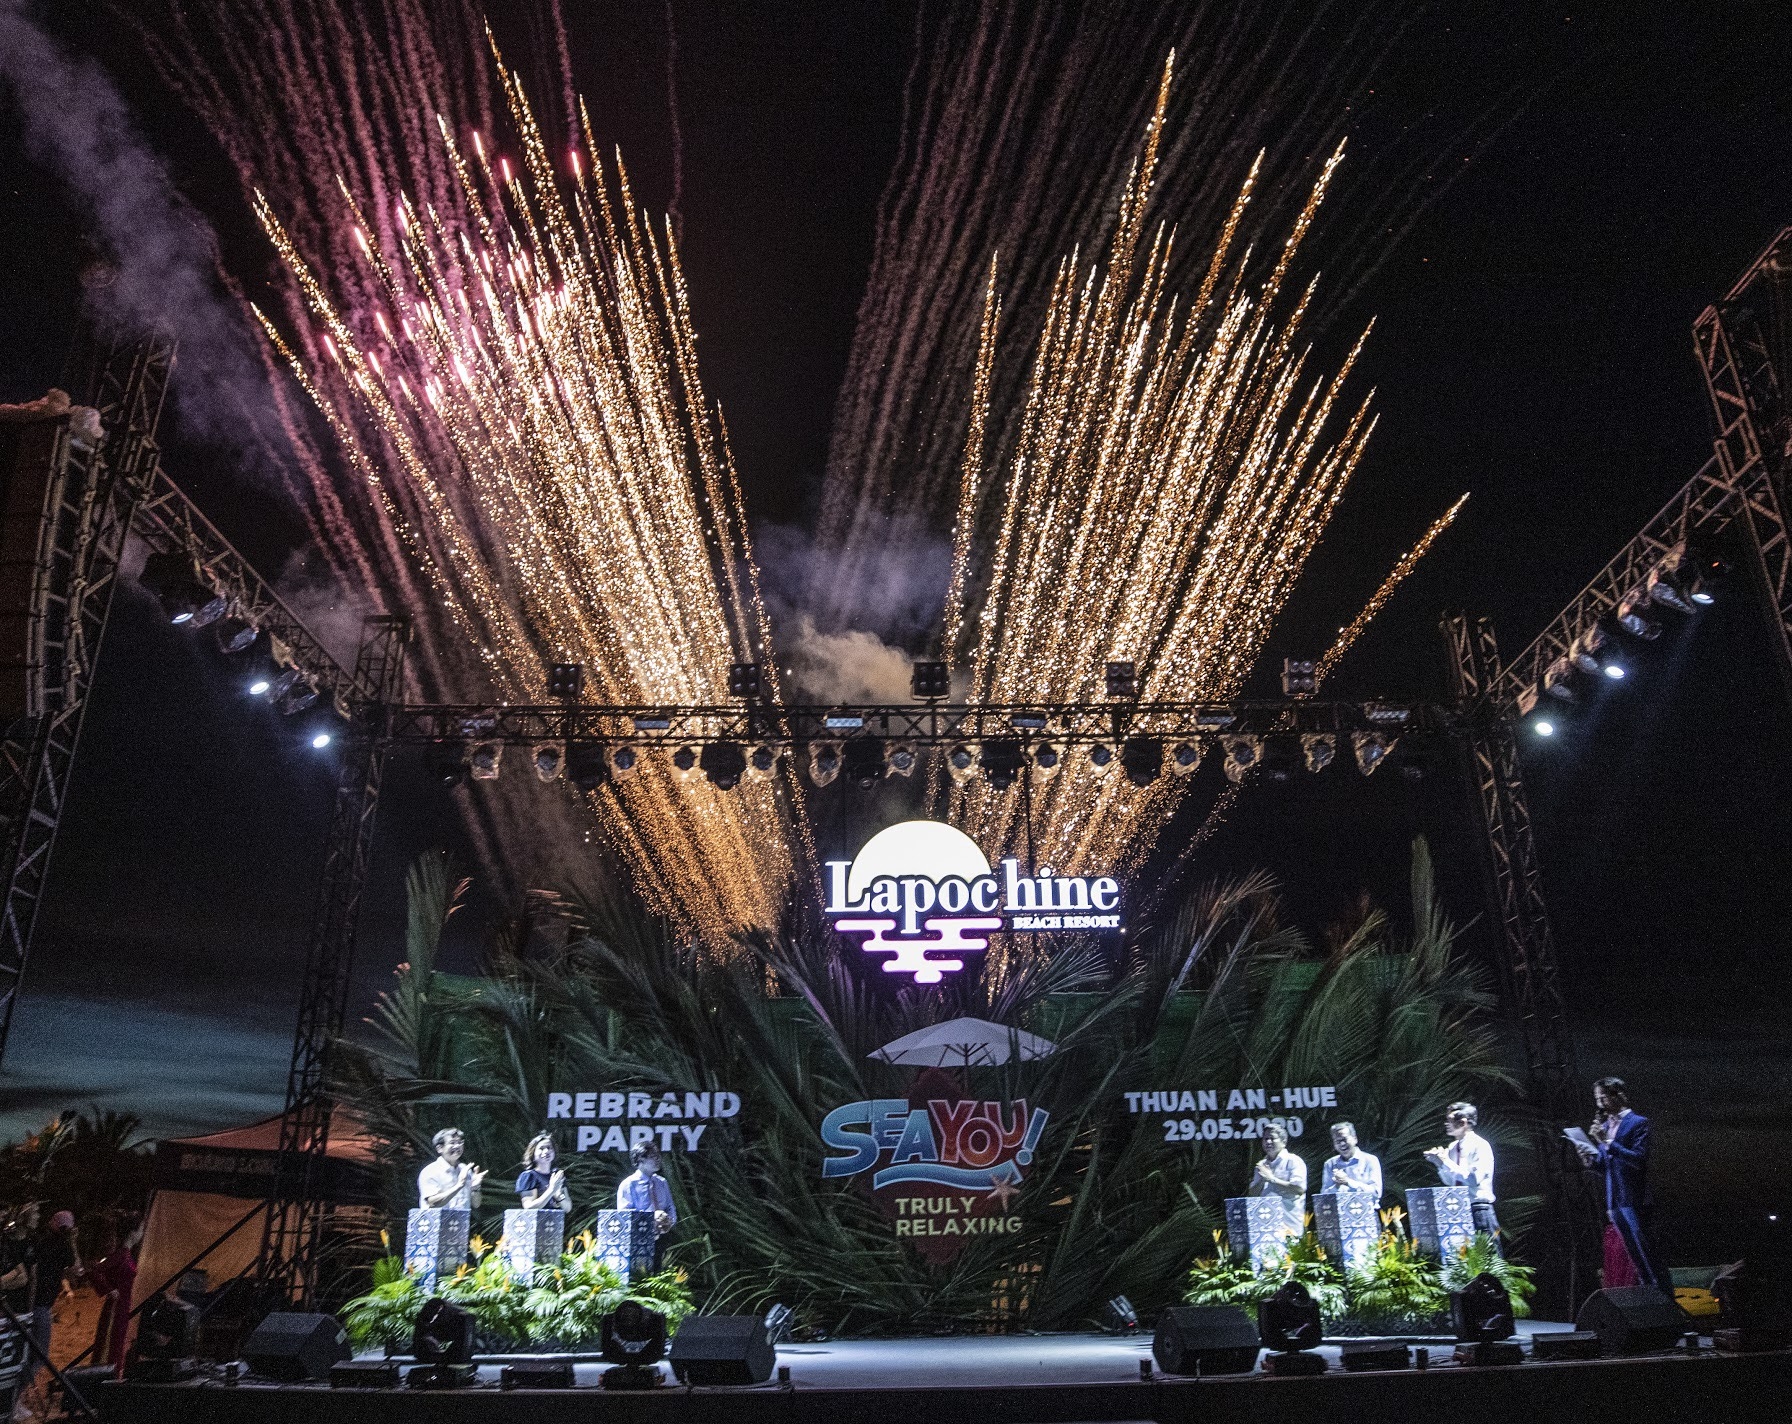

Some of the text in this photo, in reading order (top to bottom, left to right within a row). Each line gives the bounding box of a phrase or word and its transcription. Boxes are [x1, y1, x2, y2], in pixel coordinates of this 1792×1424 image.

[824, 858, 1120, 934] Lapochine
[1012, 915, 1120, 929] BEACH RESORT
[547, 1092, 741, 1118] REBRAND
[1124, 1090, 1218, 1113] THUAN
[576, 1125, 707, 1152] PARTY
[895, 1197, 976, 1215] TRULY
[895, 1216, 1023, 1237] RELAXING
